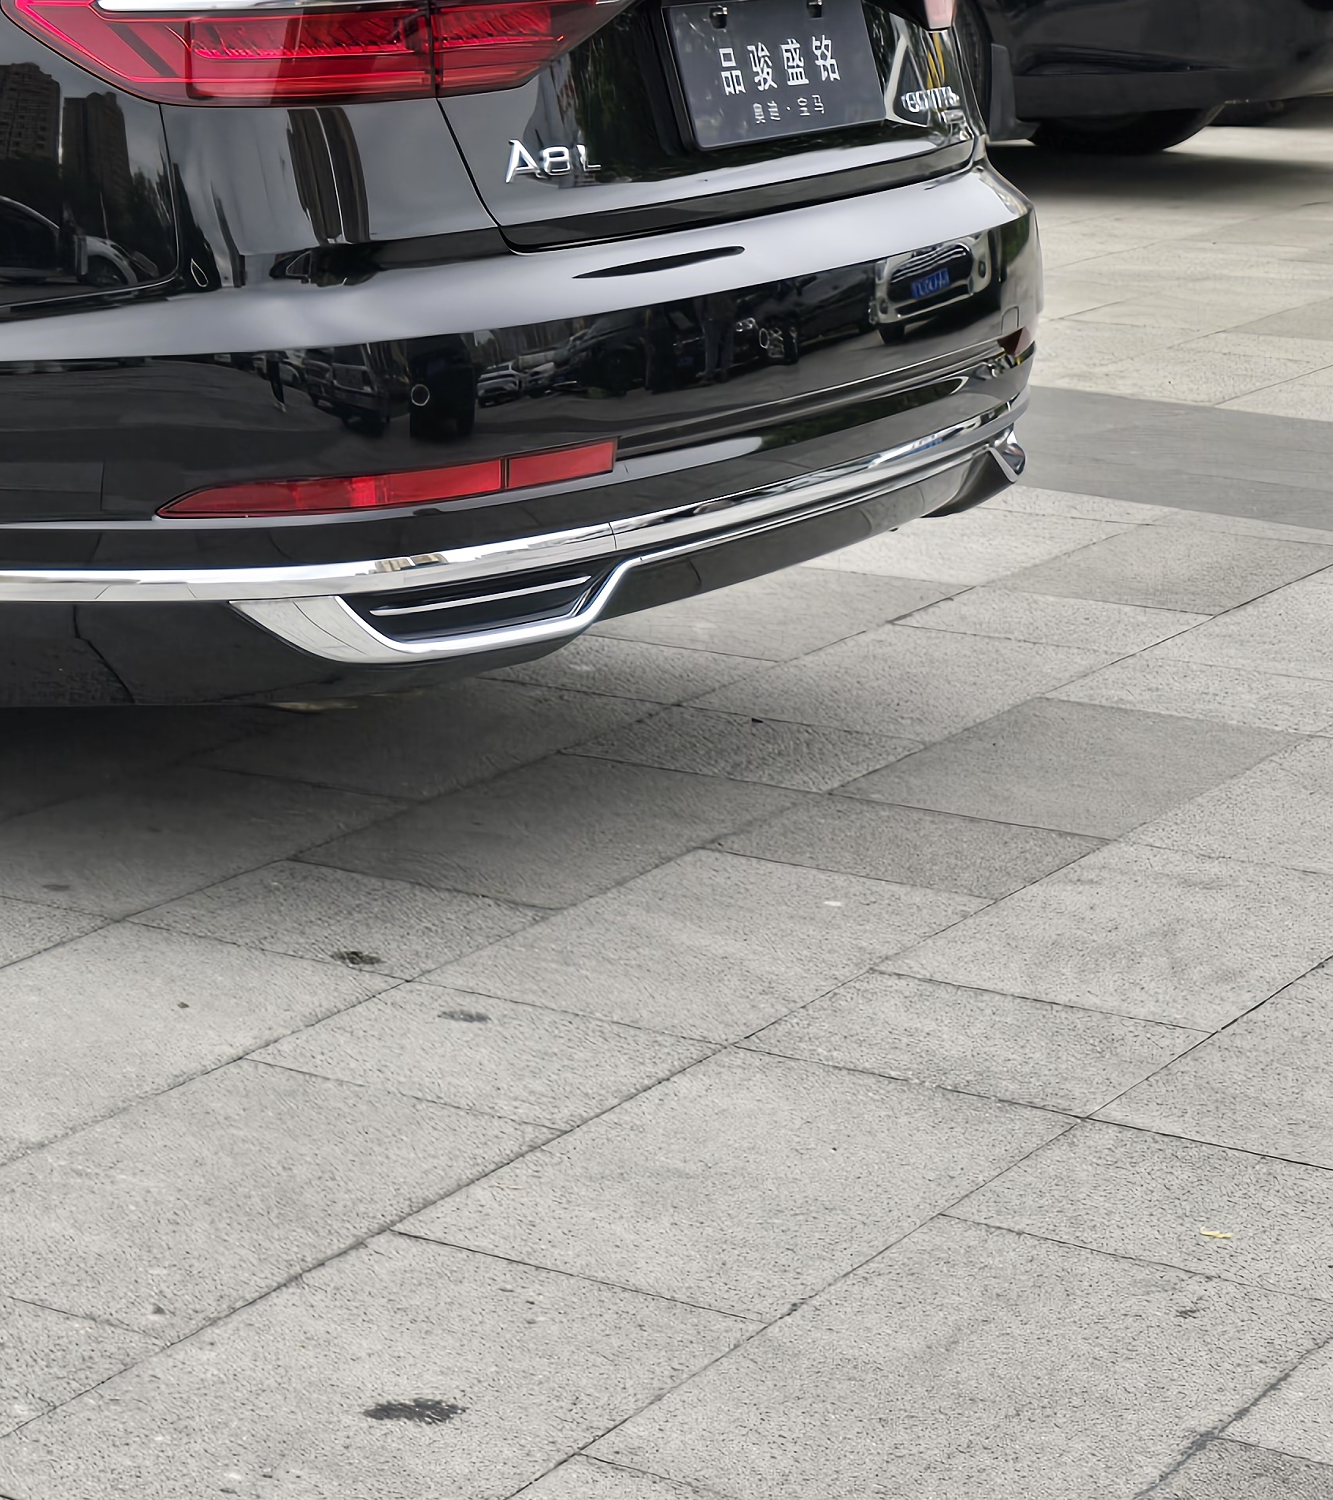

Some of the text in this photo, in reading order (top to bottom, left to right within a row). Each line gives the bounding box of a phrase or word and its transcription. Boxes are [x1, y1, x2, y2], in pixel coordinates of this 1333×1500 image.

[718, 34, 842, 97] 品骏盛铭
[505, 138, 602, 183] A8L
